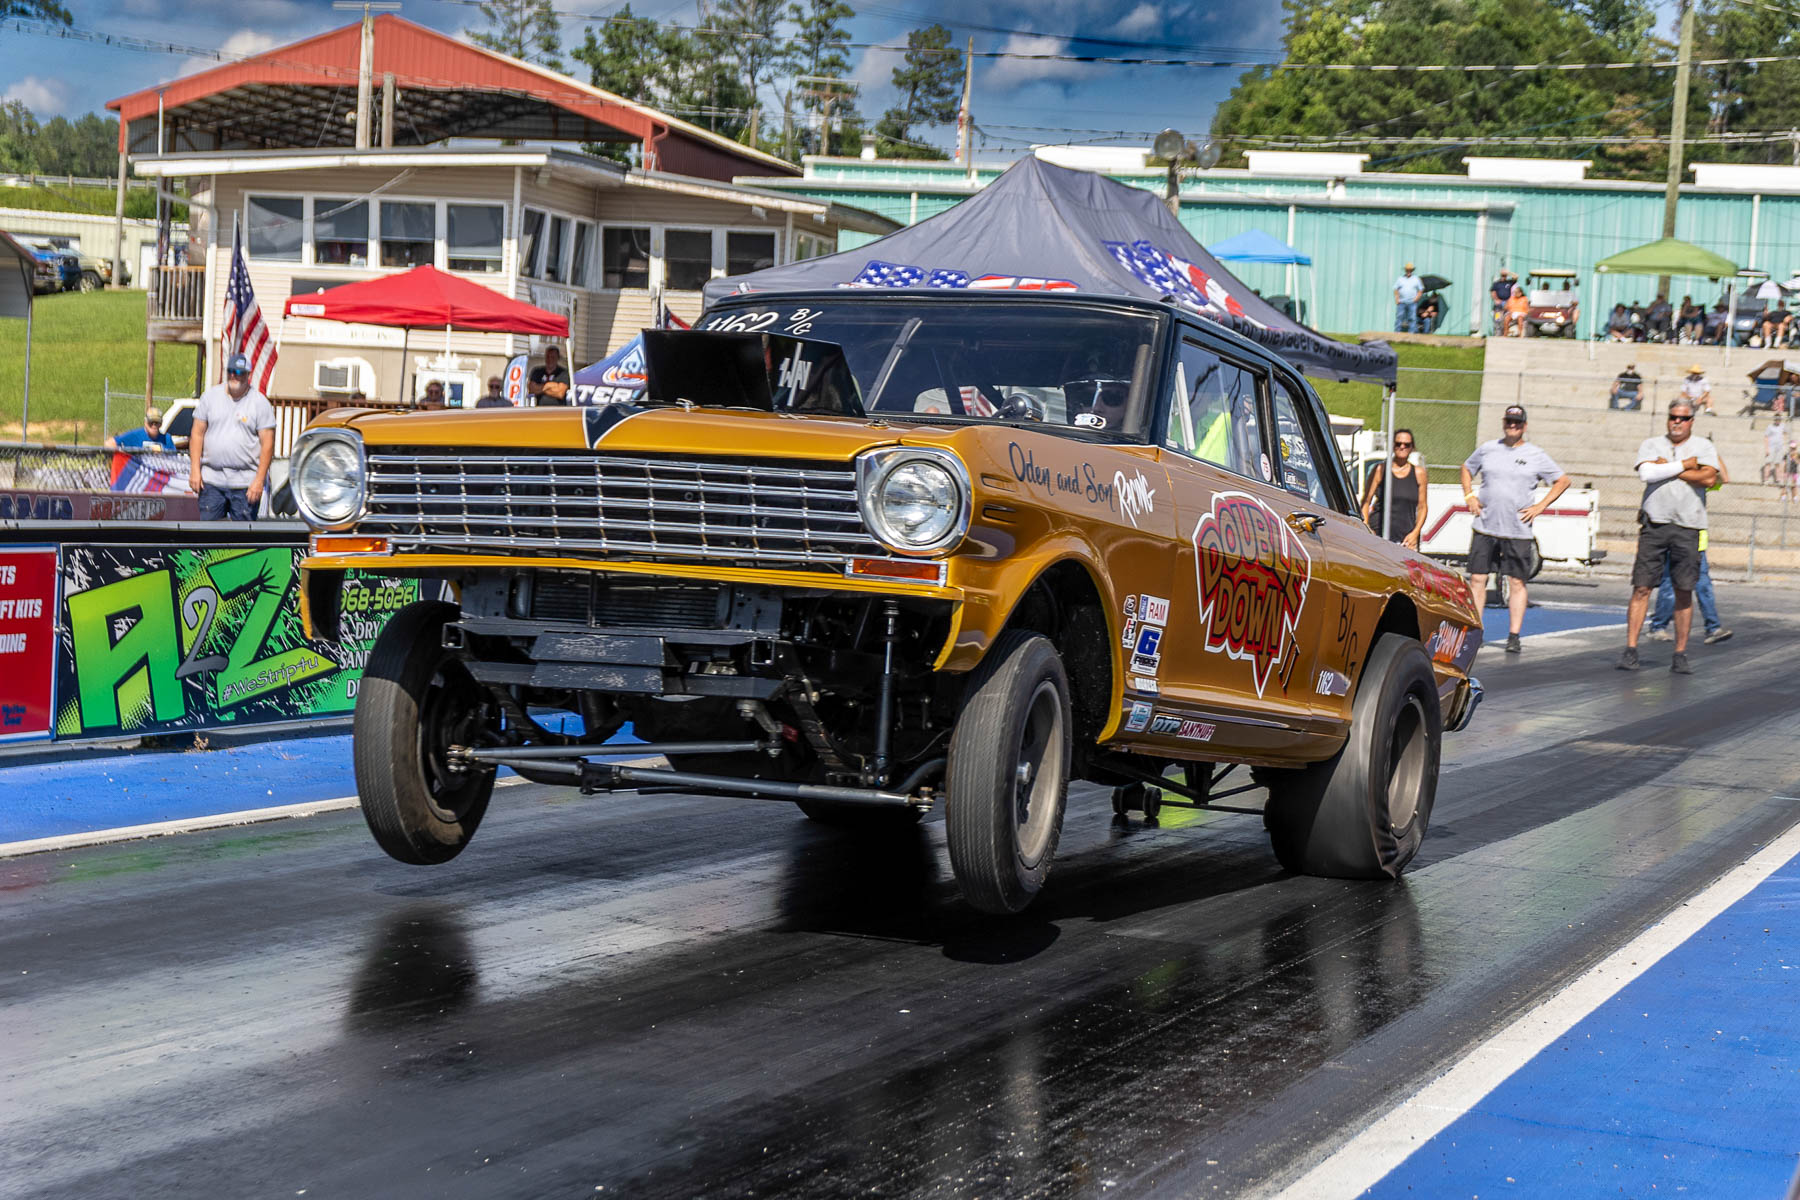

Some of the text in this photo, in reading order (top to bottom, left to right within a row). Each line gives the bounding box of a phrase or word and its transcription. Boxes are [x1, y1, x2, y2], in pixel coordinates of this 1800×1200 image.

[706, 308, 824, 336] 1162 B/G
[509, 365, 523, 408] OP
[1008, 441, 1054, 497] Oden
[1056, 465, 1084, 496] and
[1082, 462, 1117, 513] Son
[1199, 502, 1307, 614] DOUBLE
[15, 598, 43, 619] KITS
[1148, 601, 1166, 621] RAM
[1211, 576, 1286, 657] DOWN
[355, 620, 381, 640] DRY
[221, 655, 320, 702] #WeStrip4u
[1315, 669, 1335, 696] 1162
